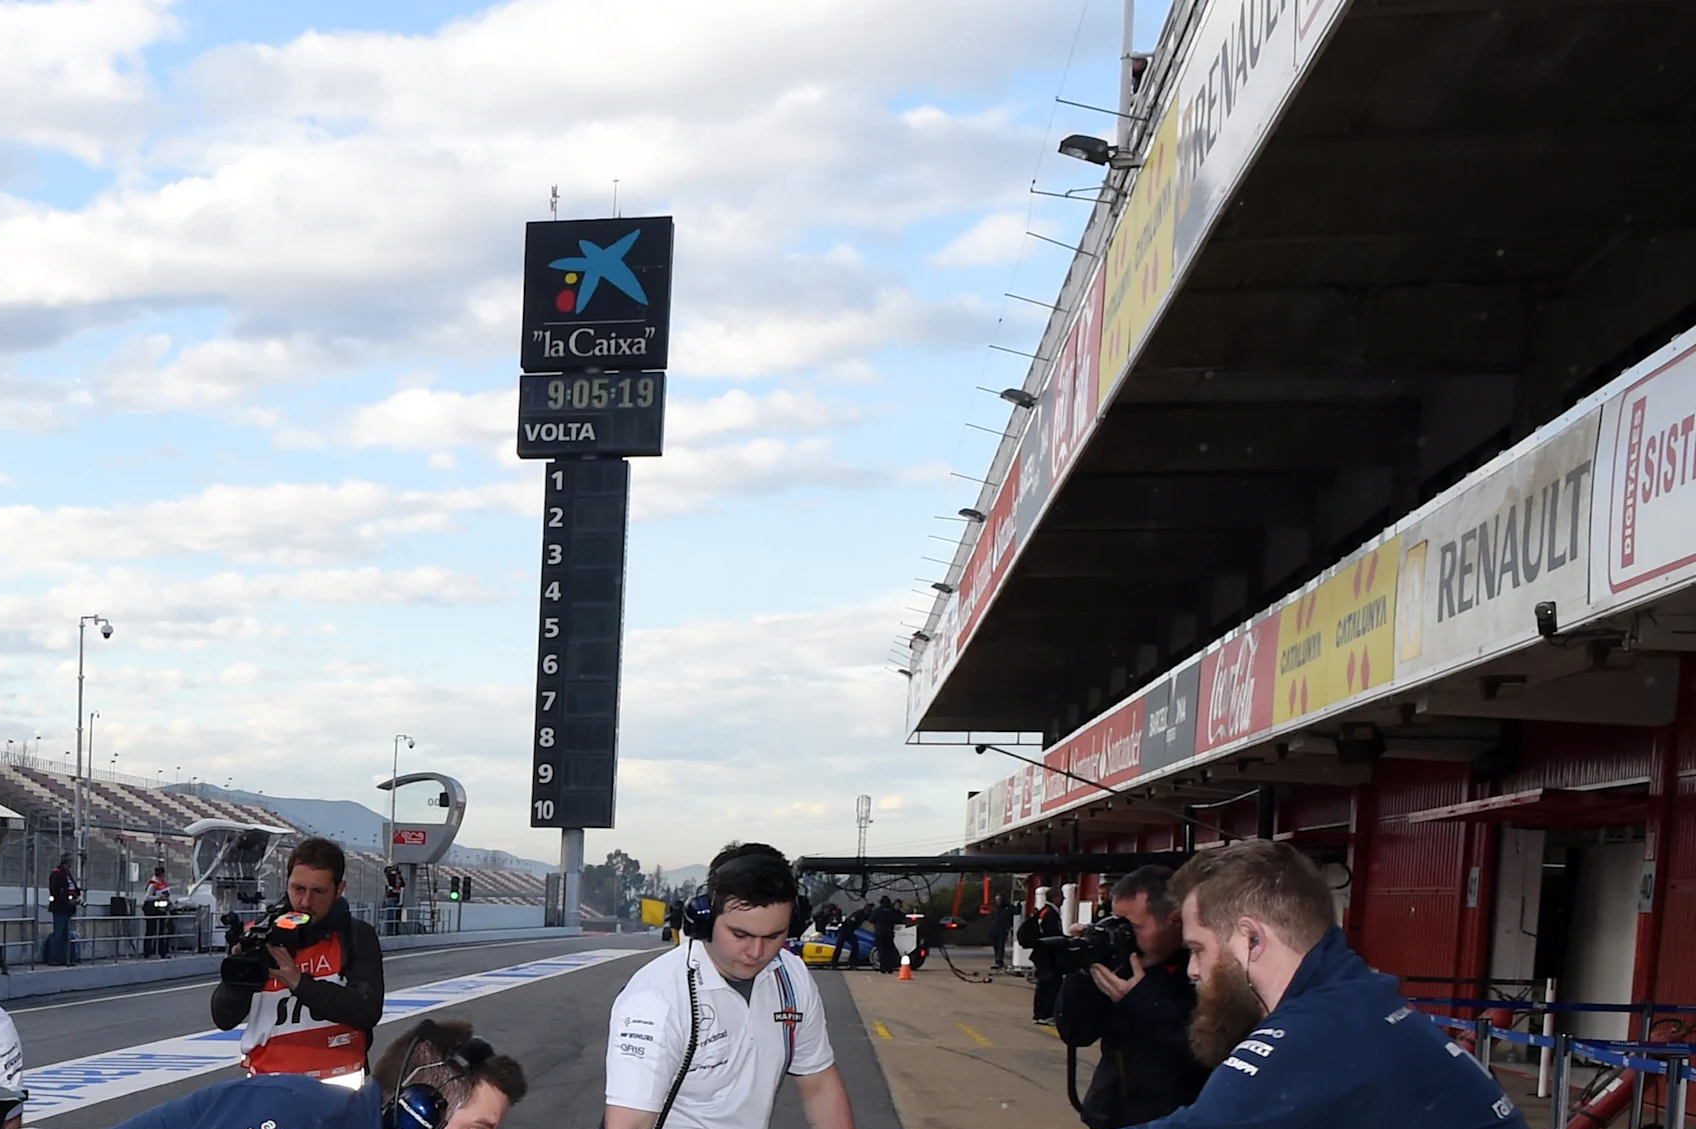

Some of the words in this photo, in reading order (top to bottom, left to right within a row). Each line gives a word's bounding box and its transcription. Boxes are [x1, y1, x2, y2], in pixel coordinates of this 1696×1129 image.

[1193, 0, 1286, 181] RENAUL
[548, 378, 654, 409] 9:05:19
[524, 423, 596, 441] VOLTA
[1642, 413, 1696, 504] SIST
[551, 471, 564, 490] 1
[548, 507, 564, 527] 2
[1437, 459, 1591, 623] RENAULT
[547, 544, 563, 564] 3
[544, 581, 561, 601] 4
[544, 617, 560, 638] 5
[1336, 595, 1387, 648] CATALUNYA
[542, 654, 558, 674] 6
[542, 691, 556, 710] 7
[539, 727, 555, 747] 8
[538, 763, 554, 784] 9
[534, 800, 555, 820] 10
